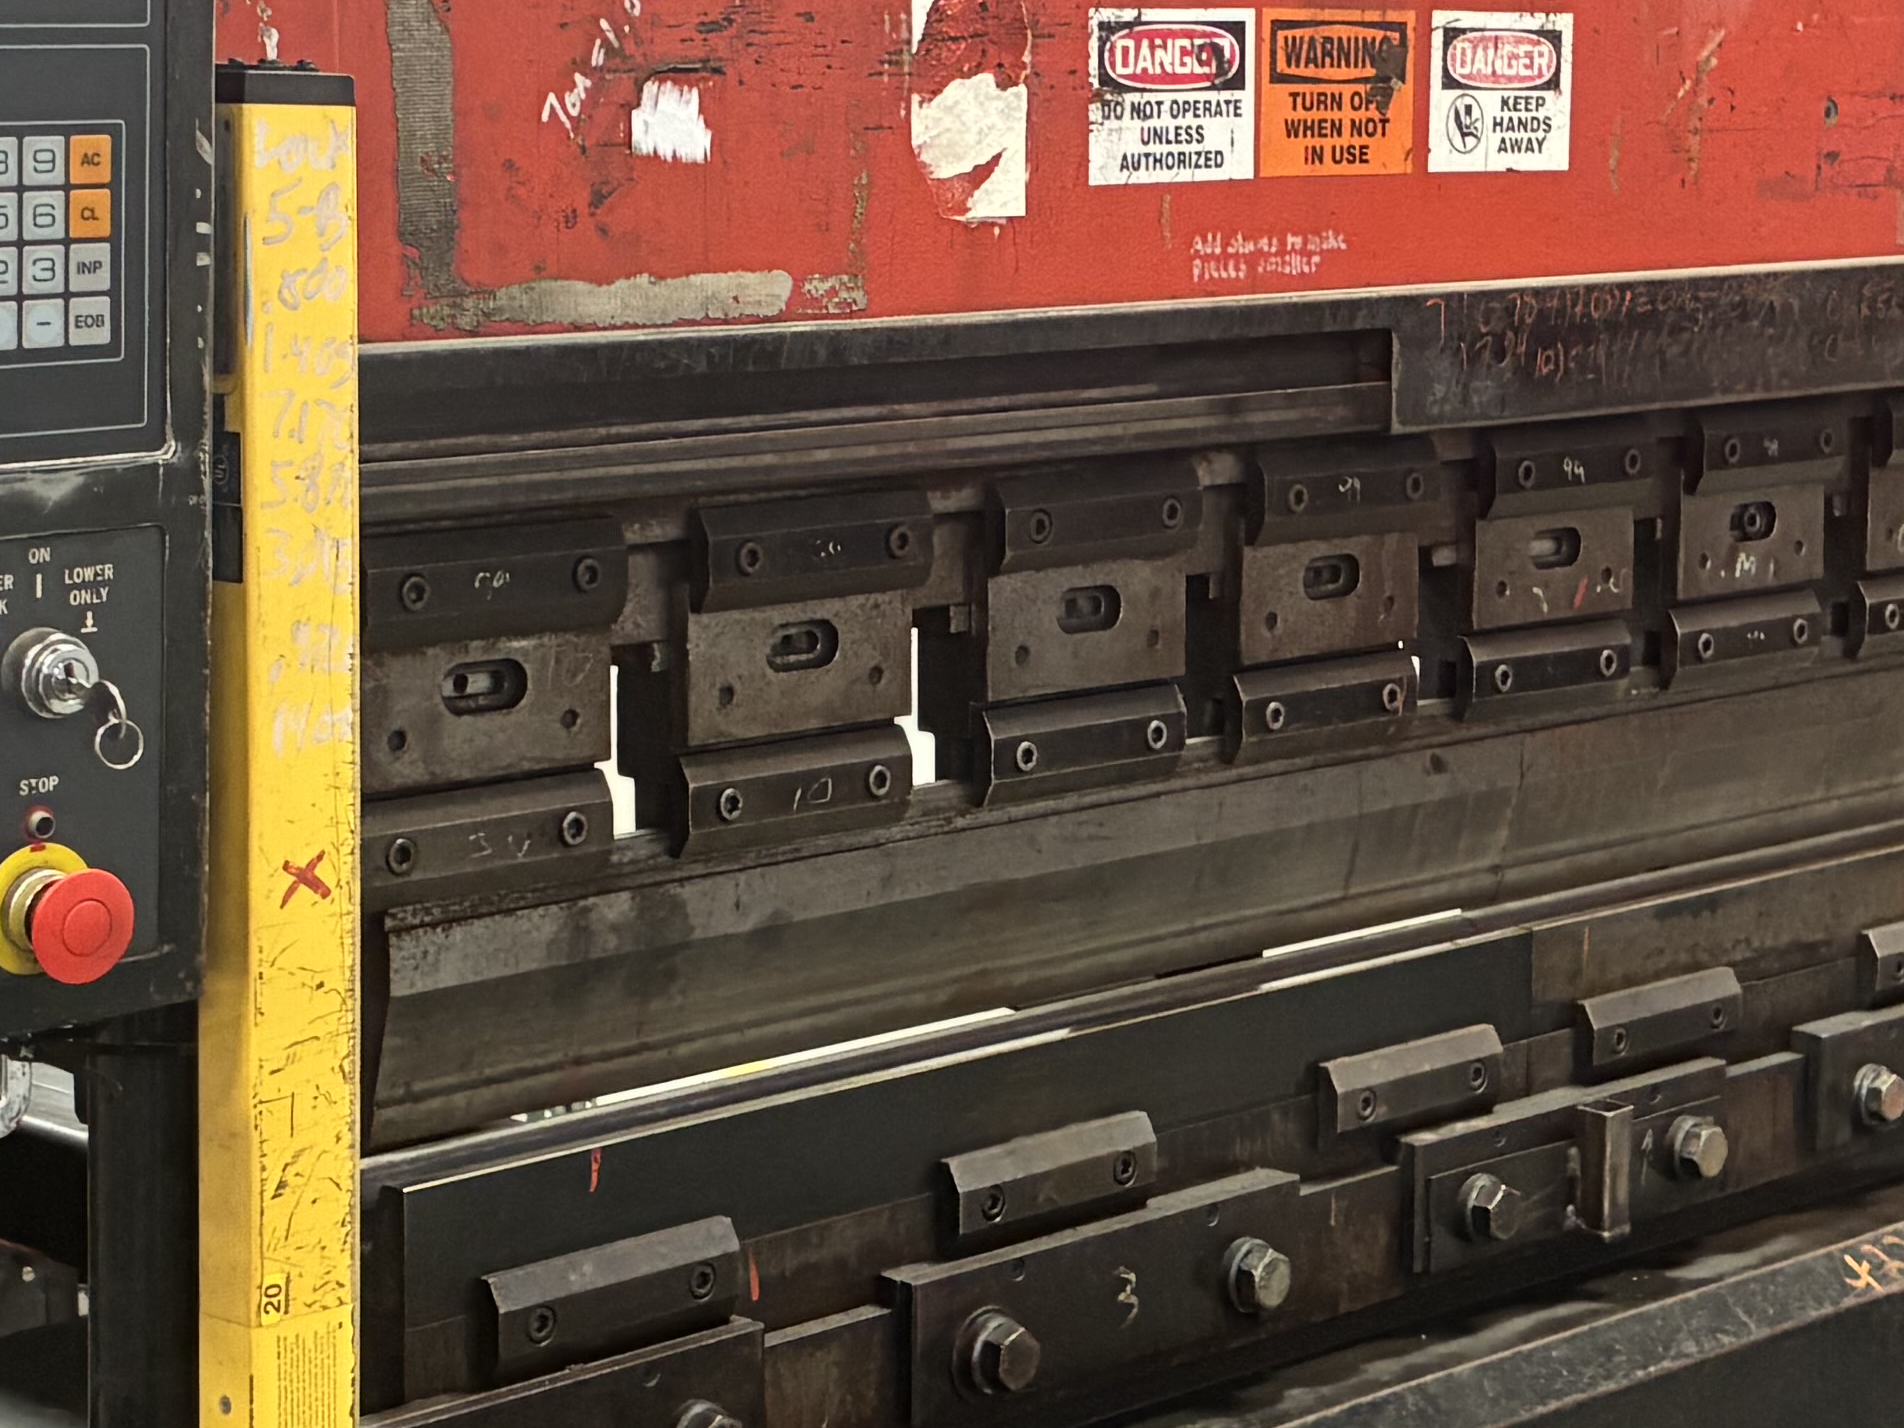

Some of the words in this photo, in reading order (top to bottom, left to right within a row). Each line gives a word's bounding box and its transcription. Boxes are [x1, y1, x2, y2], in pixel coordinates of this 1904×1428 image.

[1456, 42, 1550, 77] DANGER
[1102, 100, 1125, 121] DO
[1130, 100, 1165, 122] NOT
[1170, 99, 1243, 119] OPERATE
[1289, 92, 1343, 112] TURN
[1500, 95, 1546, 113] KEEP
[1140, 124, 1205, 146] UNLESS
[1284, 118, 1343, 139] WHEN
[1350, 118, 1390, 138] NOT
[1492, 116, 1552, 134] HANDS
[1304, 145, 1324, 165] IN
[1331, 145, 1370, 165] USE
[1497, 137, 1547, 154] AWAY
[32, 148, 56, 173] 9
[80, 152, 101, 167] AC
[1120, 150, 1224, 172] AUTHORIZED
[32, 203, 56, 228] 6
[80, 207, 99, 221] CL
[32, 257, 56, 282] 3
[76, 260, 103, 275] INP
[74, 314, 105, 329] EOB
[28, 547, 51, 564] ON
[64, 563, 114, 584] LOWER
[69, 586, 109, 605] ONLY
[19, 775, 60, 796] STOP
[263, 1283, 282, 1314] 20
